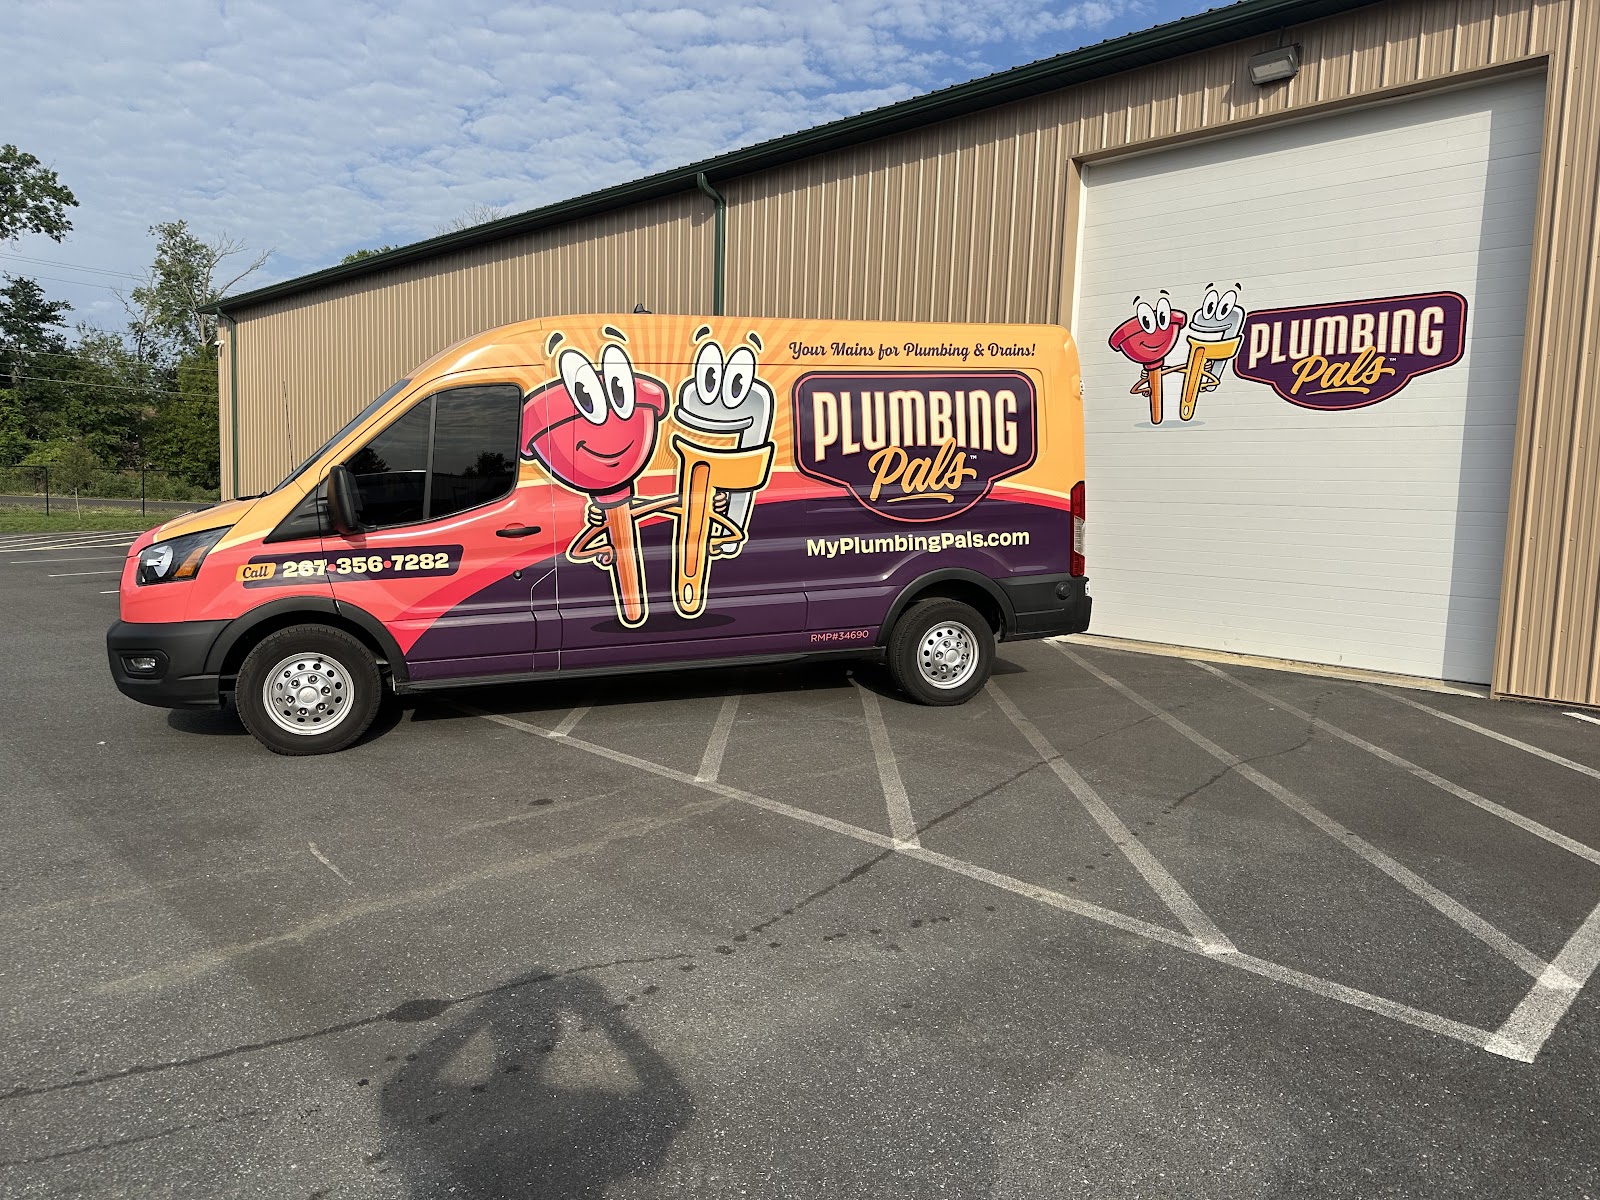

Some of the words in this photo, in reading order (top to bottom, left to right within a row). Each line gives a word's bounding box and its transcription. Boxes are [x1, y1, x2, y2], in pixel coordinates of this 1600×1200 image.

[788, 341, 826, 360] Your
[830, 342, 875, 357] Mains
[877, 343, 900, 360] for
[903, 342, 970, 361] Plumbing
[974, 343, 985, 357] &
[987, 342, 1036, 357] Drains!
[1248, 305, 1446, 370] PLUMBING
[1290, 345, 1396, 395] Pals
[812, 389, 1018, 463] PLUMBING
[867, 437, 978, 502] Pals
[806, 530, 1030, 559] MyPlumbingPals.com
[242, 566, 269, 579] Call
[810, 629, 869, 643] RMP#34690
